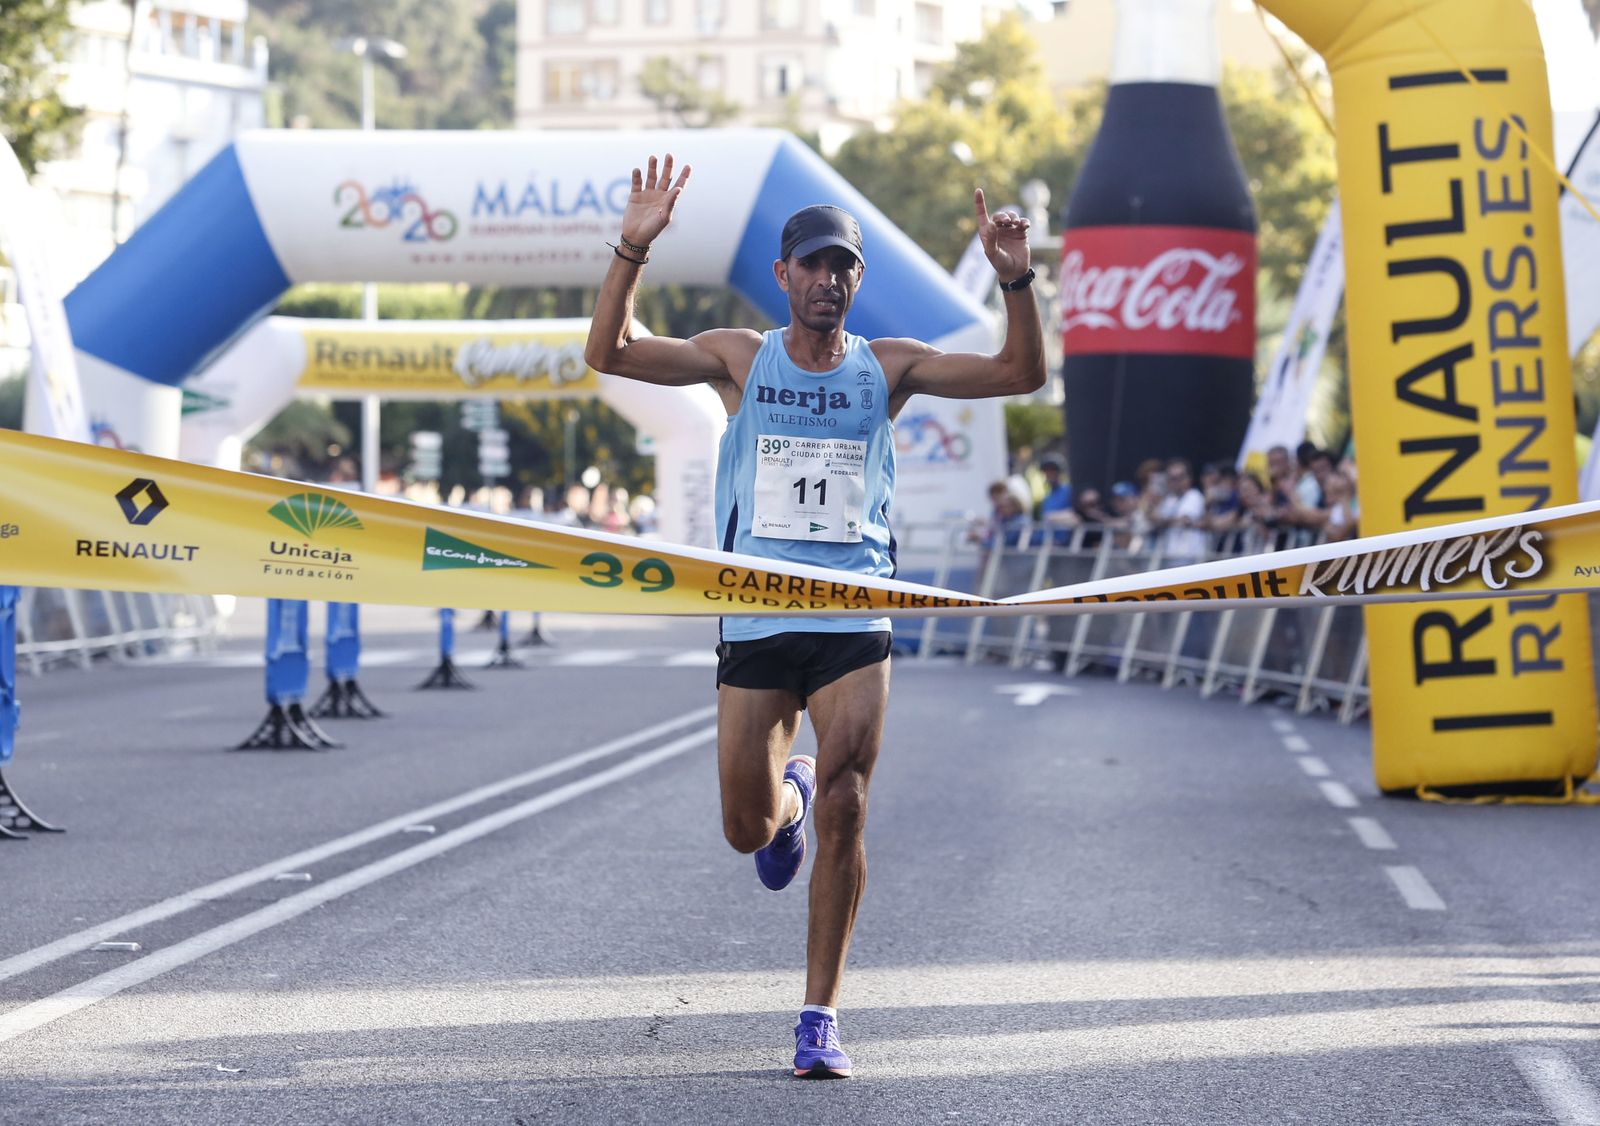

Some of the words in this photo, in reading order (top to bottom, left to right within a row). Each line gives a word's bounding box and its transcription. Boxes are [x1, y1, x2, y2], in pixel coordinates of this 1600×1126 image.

[470, 172, 634, 218] MÁLAG
[756, 384, 851, 416] nerja
[1377, 121, 1498, 690] RNAULT
[767, 412, 838, 428] ATLETISMO
[791, 450, 821, 459] CIUDAD
[823, 451, 833, 459] DE
[795, 441, 831, 450] CARRERA
[793, 477, 826, 506] 11
[0, 522, 20, 539] ga
[76, 539, 200, 562] RENAULT
[270, 541, 352, 565] Unicaja
[263, 564, 354, 581] Fundación
[578, 551, 675, 593] 39
[718, 567, 872, 602] CARRERA
[1072, 569, 1290, 604] nault
